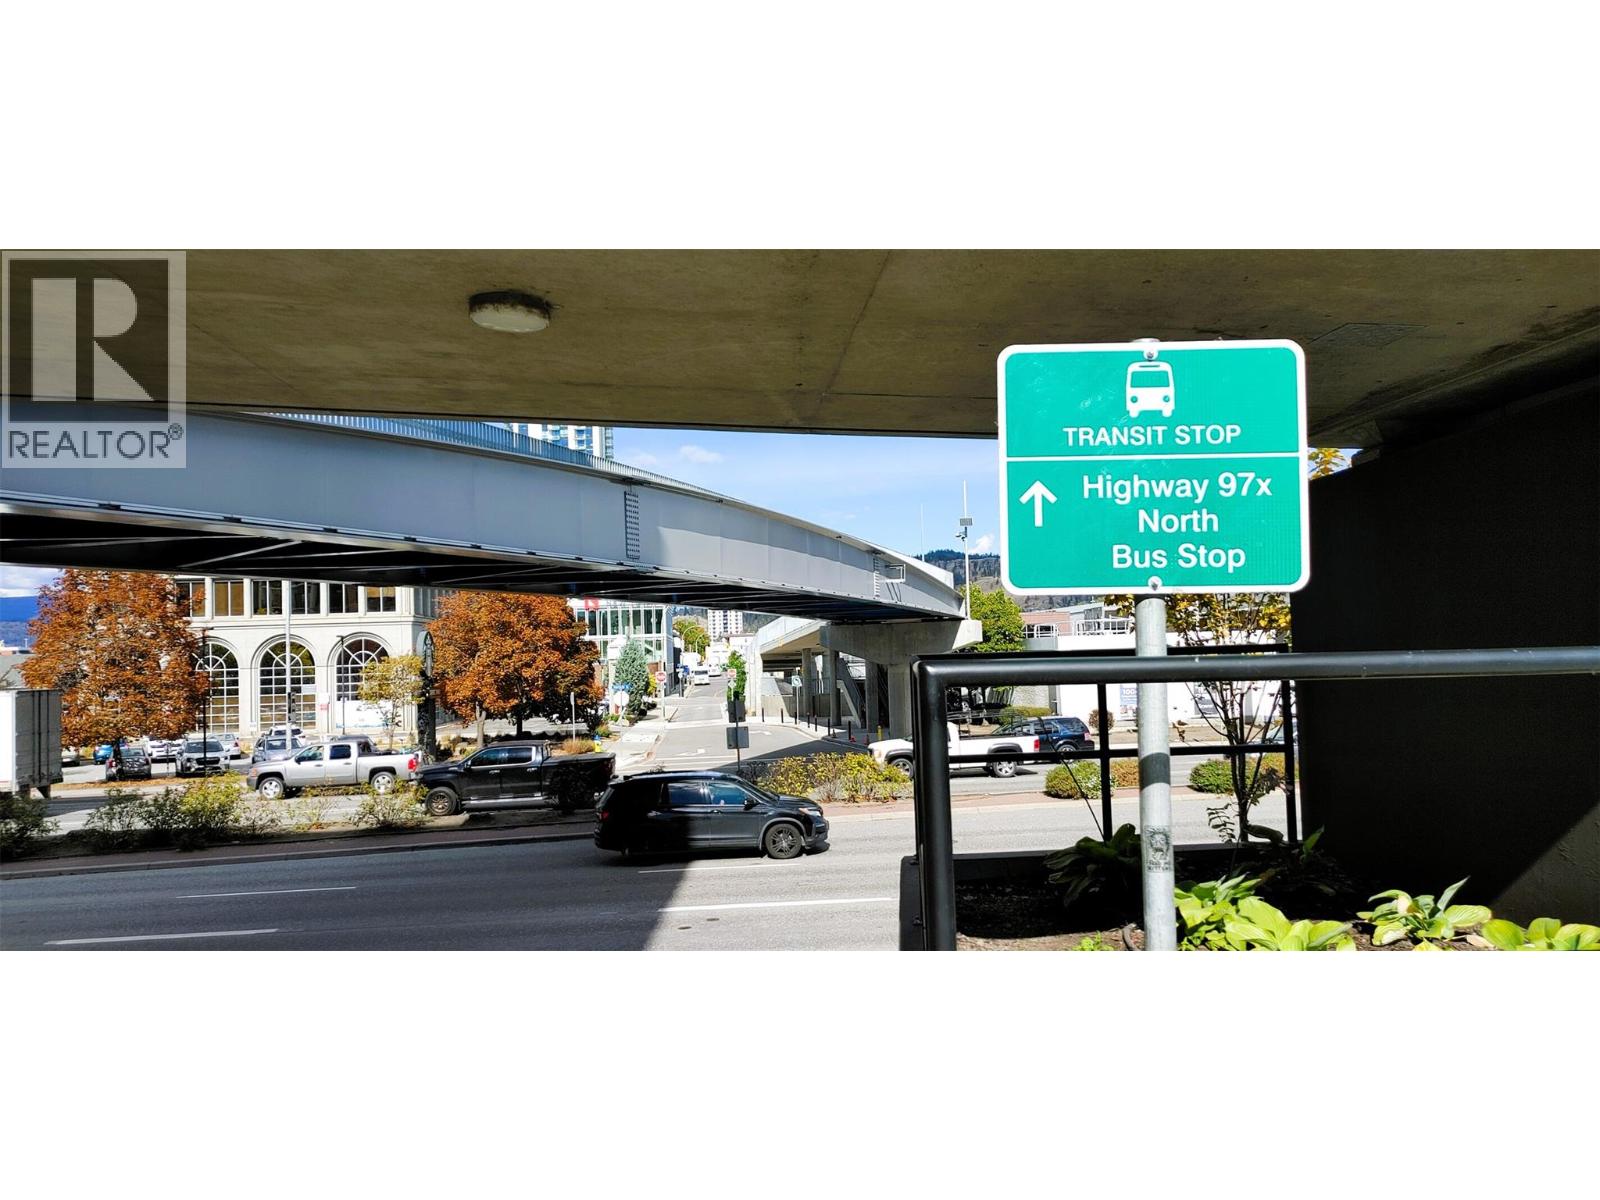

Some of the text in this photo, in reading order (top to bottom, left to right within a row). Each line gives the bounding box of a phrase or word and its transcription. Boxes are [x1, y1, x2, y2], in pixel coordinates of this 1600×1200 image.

[1063, 424, 1241, 446] TRANSIT STOP
[1083, 471, 1272, 505] Highway 97x
[1138, 508, 1219, 533] North
[1112, 543, 1246, 573] Bus Stop
